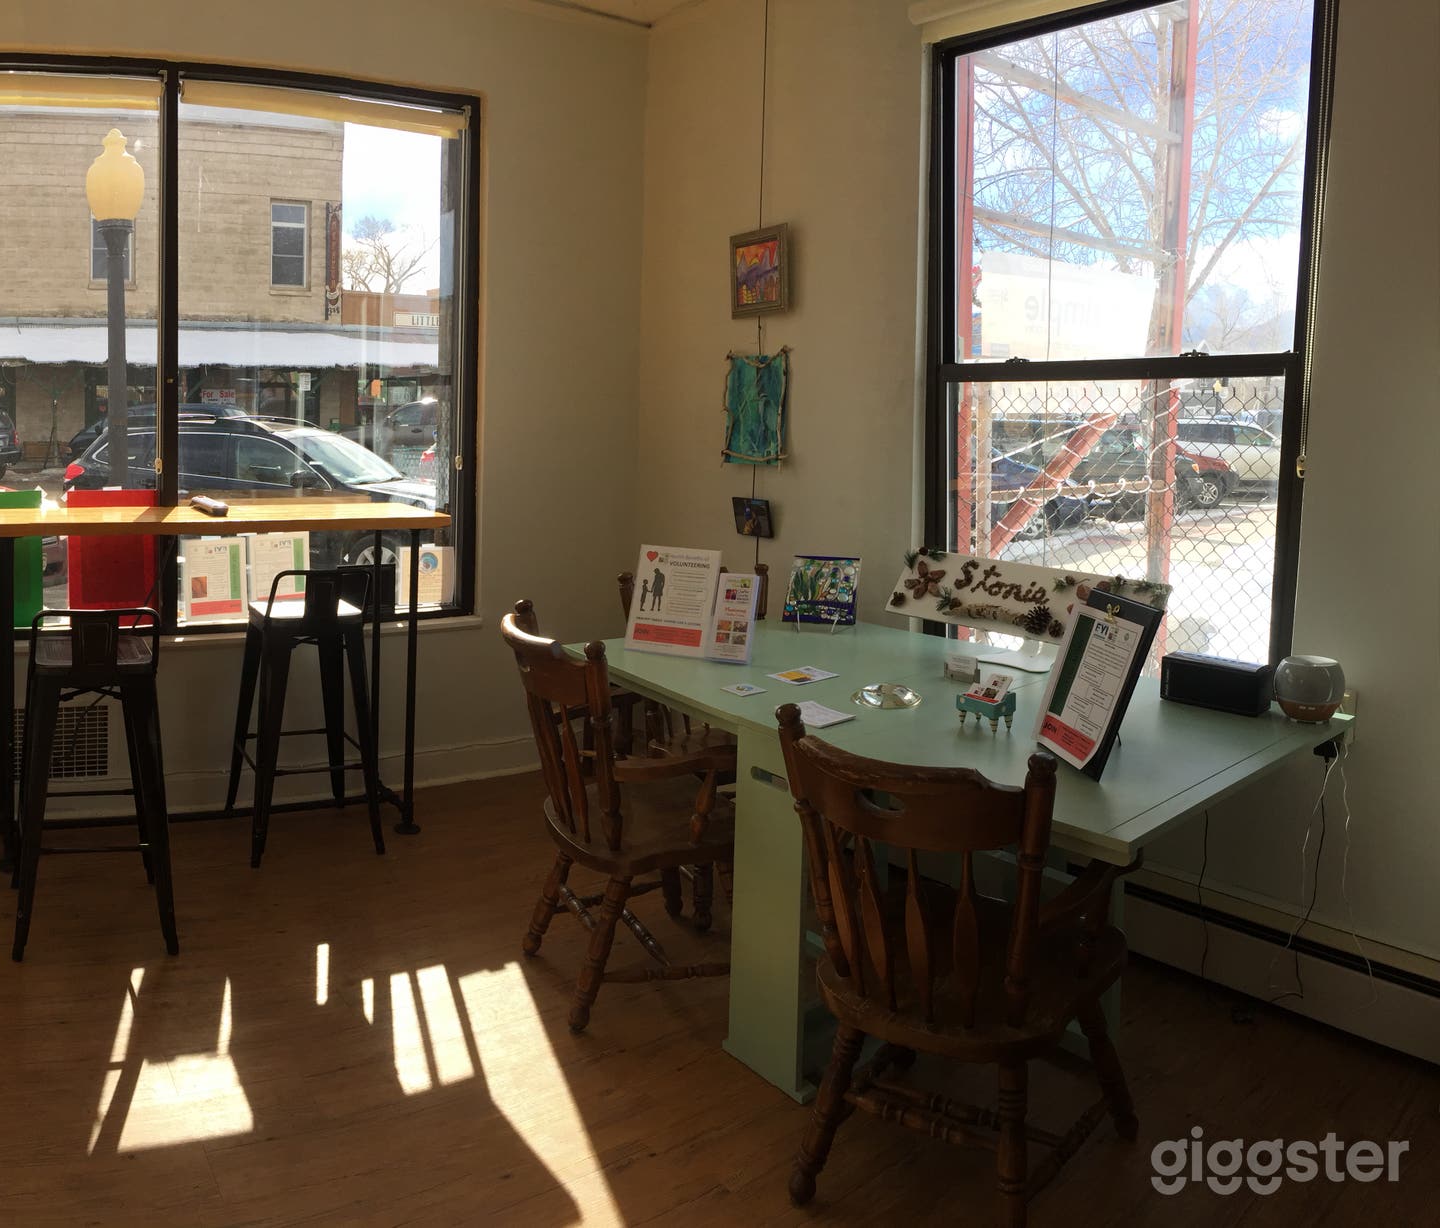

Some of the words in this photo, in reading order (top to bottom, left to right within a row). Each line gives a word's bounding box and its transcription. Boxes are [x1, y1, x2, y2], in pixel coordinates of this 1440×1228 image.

[202, 390, 213, 398] For
[219, 390, 235, 398] Sale
[669, 560, 711, 569] VOLUNTEERING
